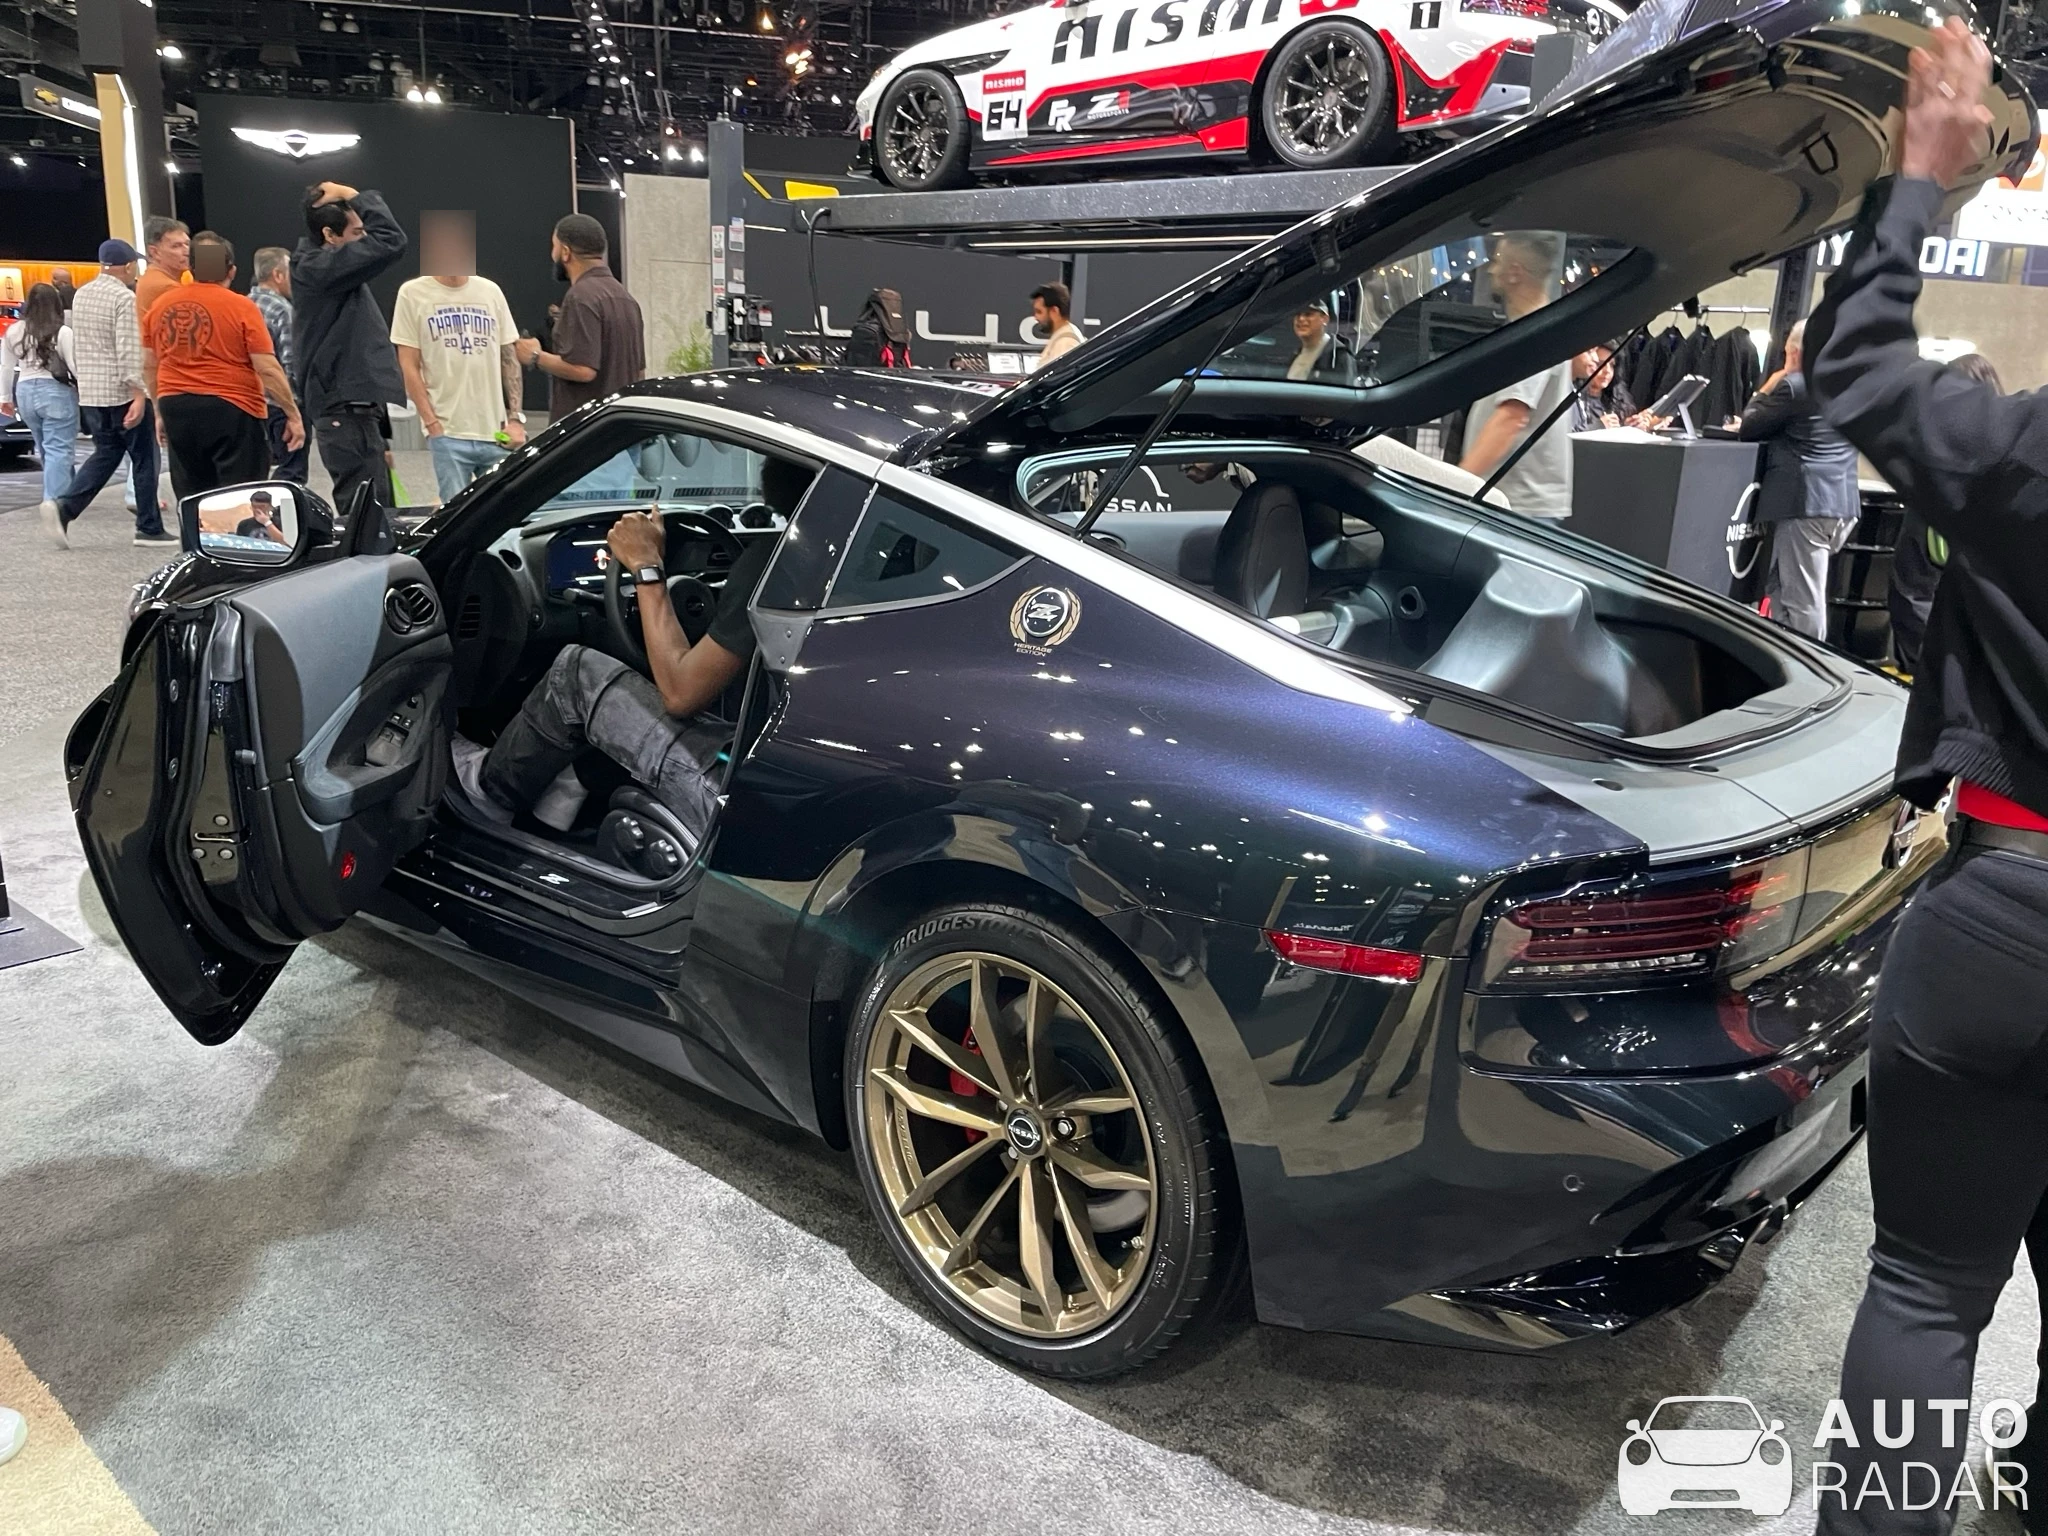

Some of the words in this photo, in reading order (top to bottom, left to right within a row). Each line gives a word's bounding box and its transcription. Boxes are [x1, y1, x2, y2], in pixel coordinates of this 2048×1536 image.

[1419, 2, 1431, 28] 1
[987, 98, 1022, 132] 64
[1087, 109, 1130, 120] MOTORSPORTS
[437, 306, 462, 315] WORLD
[1104, 498, 1172, 512] SSAN
[1013, 642, 1053, 654] HERITAGE
[1016, 647, 1046, 657] EDITION
[893, 913, 1039, 958] BRIDGESTONE
[1008, 1124, 1041, 1141] NISSAN
